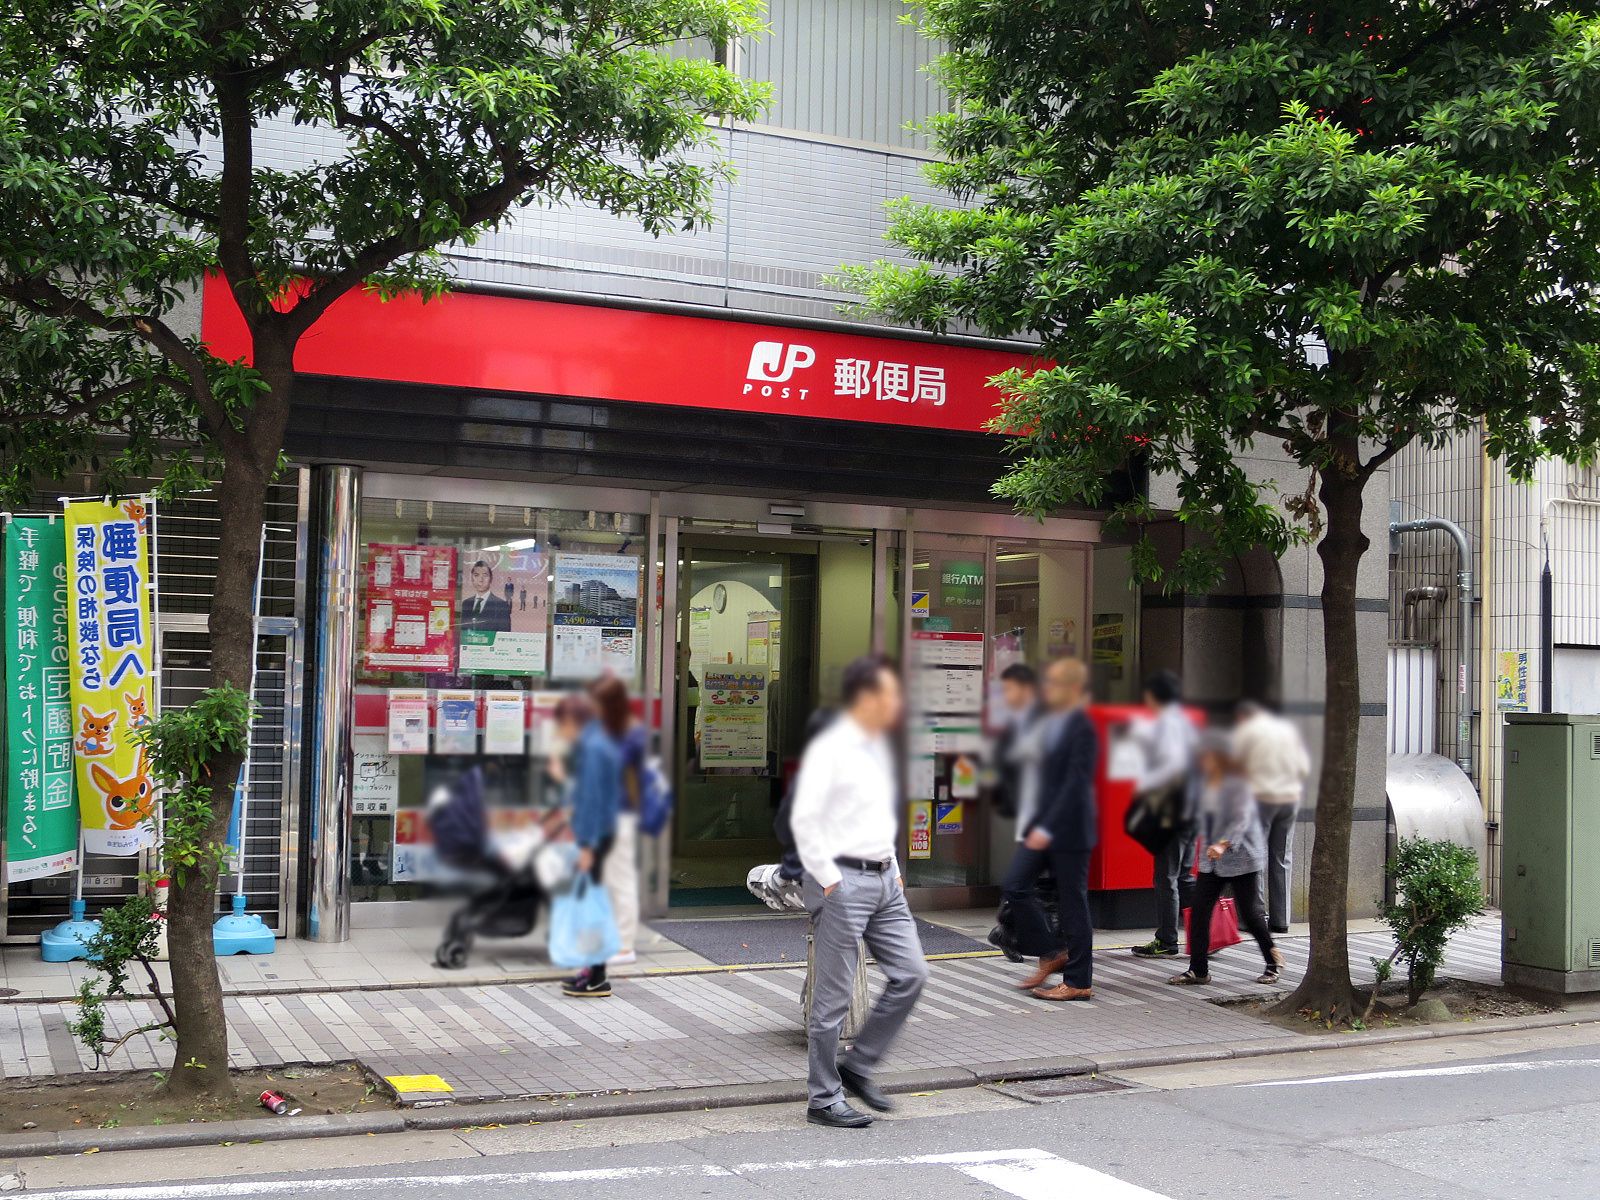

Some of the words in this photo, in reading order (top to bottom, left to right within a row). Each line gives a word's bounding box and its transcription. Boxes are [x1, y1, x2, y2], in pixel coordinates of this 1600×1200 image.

[746, 341, 816, 383] JP
[742, 383, 809, 400] POST
[833, 357, 946, 406] 郵便局
[941, 573, 984, 586] 銀行ATM
[1518, 652, 1527, 704] 男性募集
[356, 802, 388, 812] 回収箱
